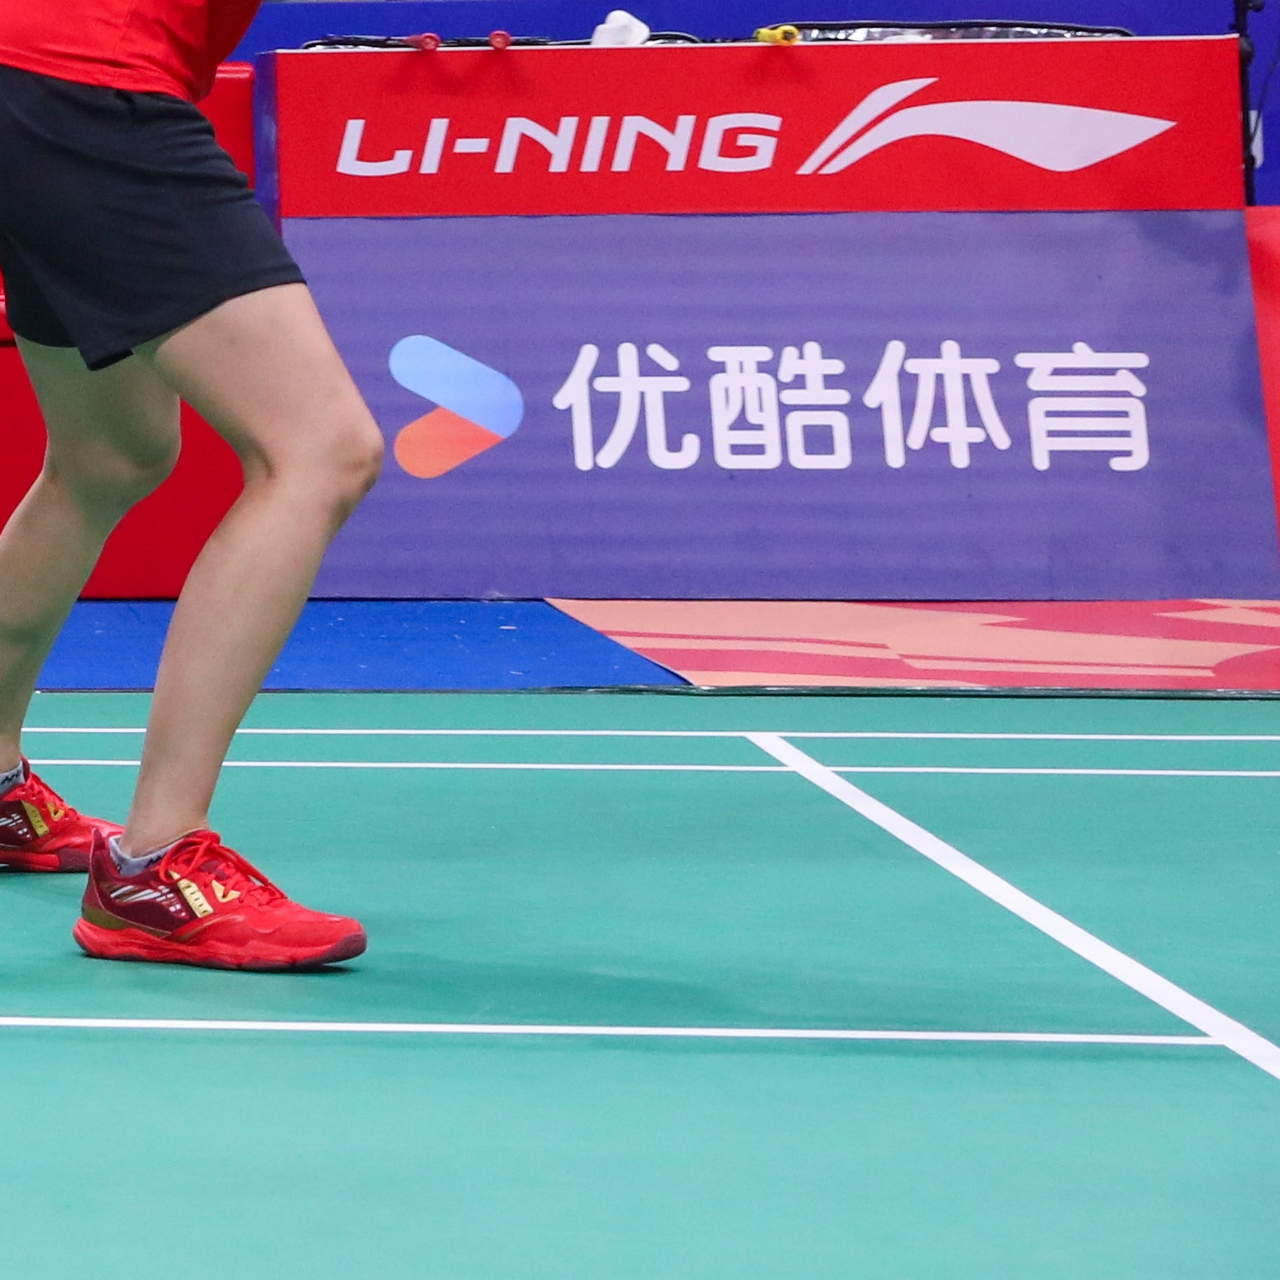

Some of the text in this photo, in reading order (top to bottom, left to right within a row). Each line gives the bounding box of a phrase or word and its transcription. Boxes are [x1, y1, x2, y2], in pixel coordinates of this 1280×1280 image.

[335, 113, 782, 176] LI-NING
[553, 340, 1150, 471] 优酷体育
